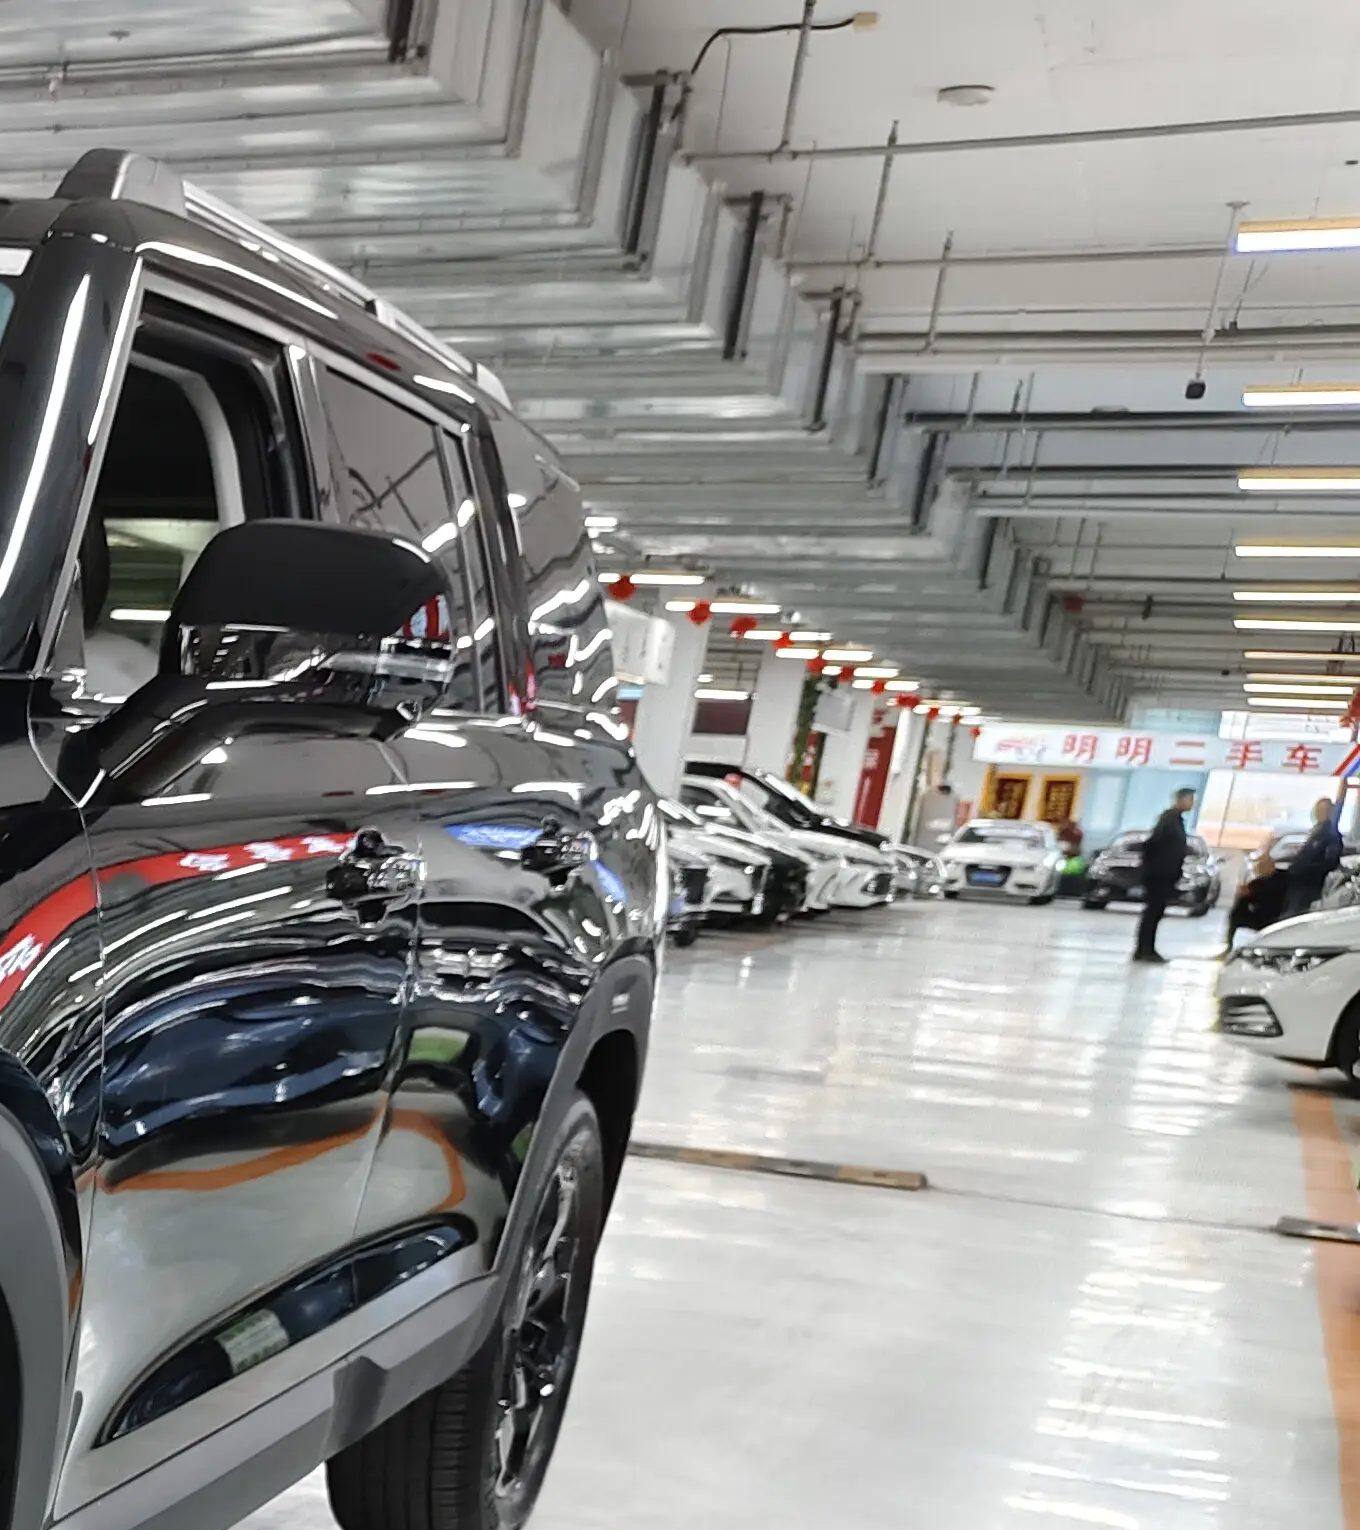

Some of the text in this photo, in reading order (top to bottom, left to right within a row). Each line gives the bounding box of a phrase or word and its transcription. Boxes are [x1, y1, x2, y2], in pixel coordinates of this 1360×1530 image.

[1062, 734, 1323, 773] 明明二手车
